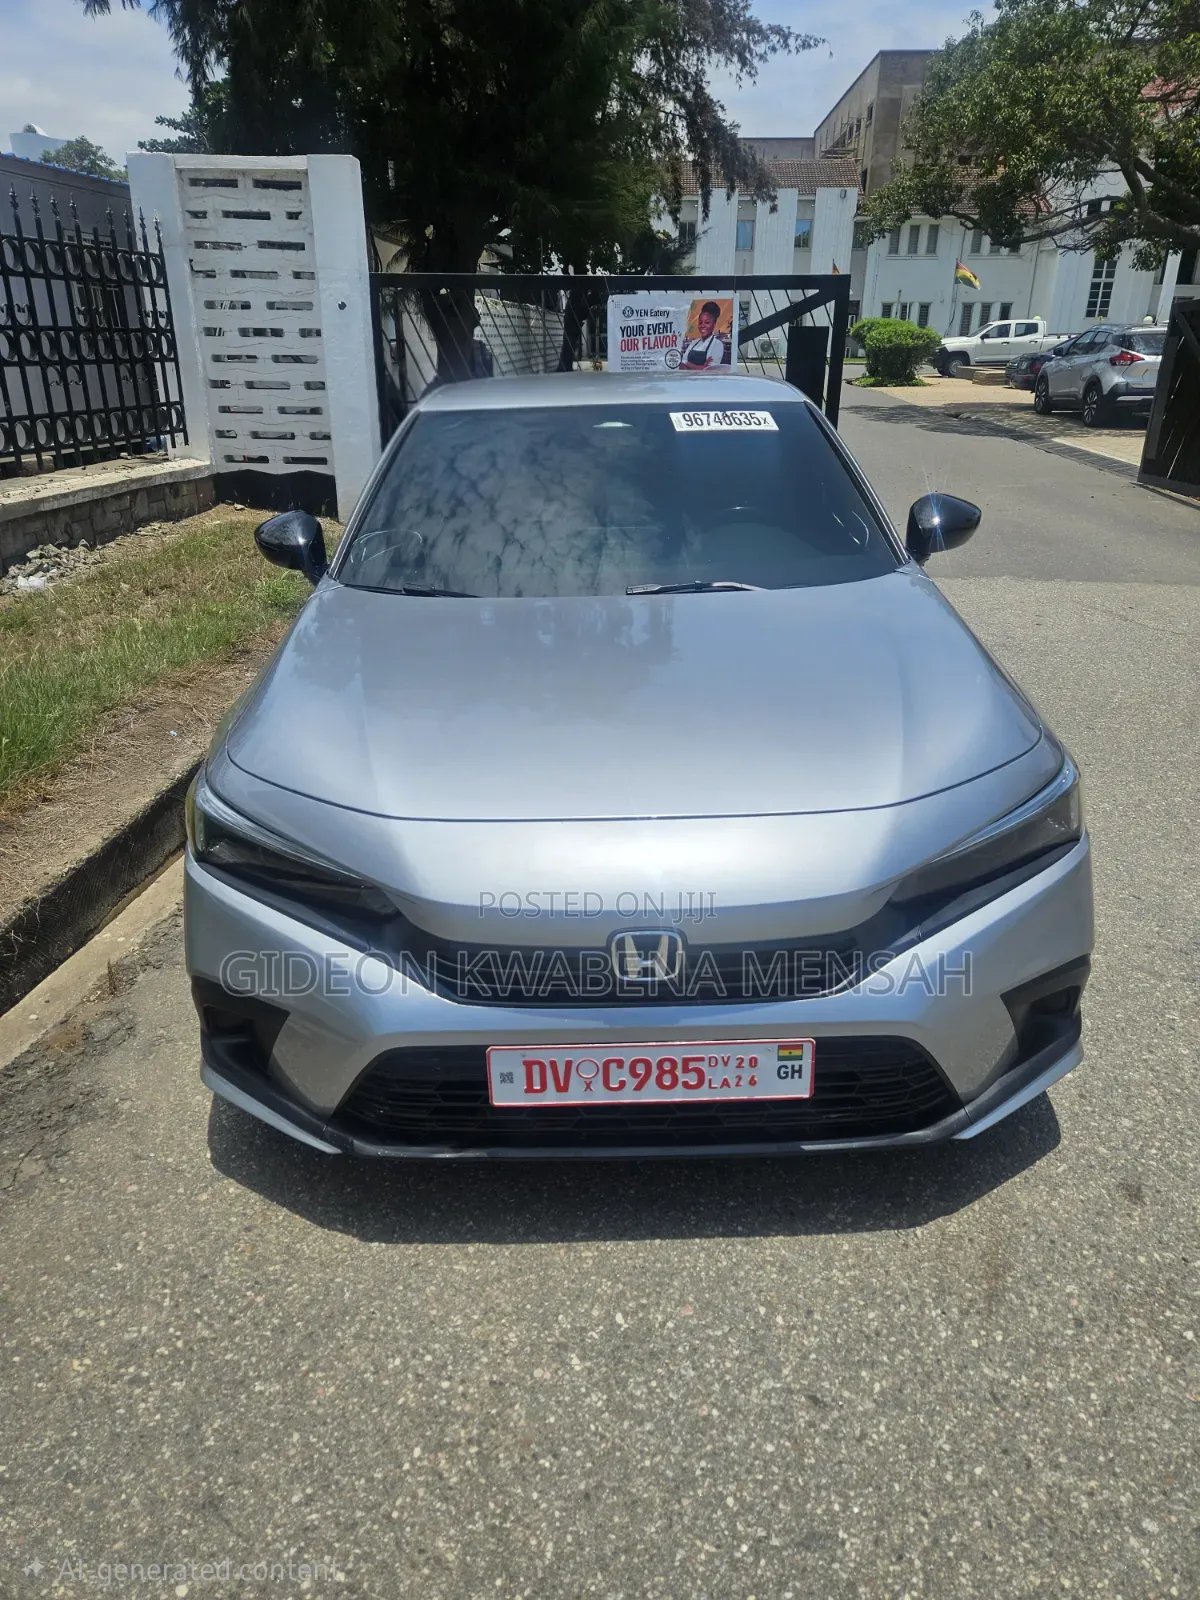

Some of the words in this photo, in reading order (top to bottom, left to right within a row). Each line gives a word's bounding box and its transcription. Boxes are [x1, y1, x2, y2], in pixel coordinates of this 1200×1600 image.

[635, 308, 649, 317] YEN
[650, 308, 670, 319] Eatery
[620, 324, 644, 338] YOUR
[647, 322, 676, 336] EVENT,
[620, 337, 639, 352] OUR
[642, 334, 678, 351] FLAVOR
[776, 1064, 803, 1080] GH
